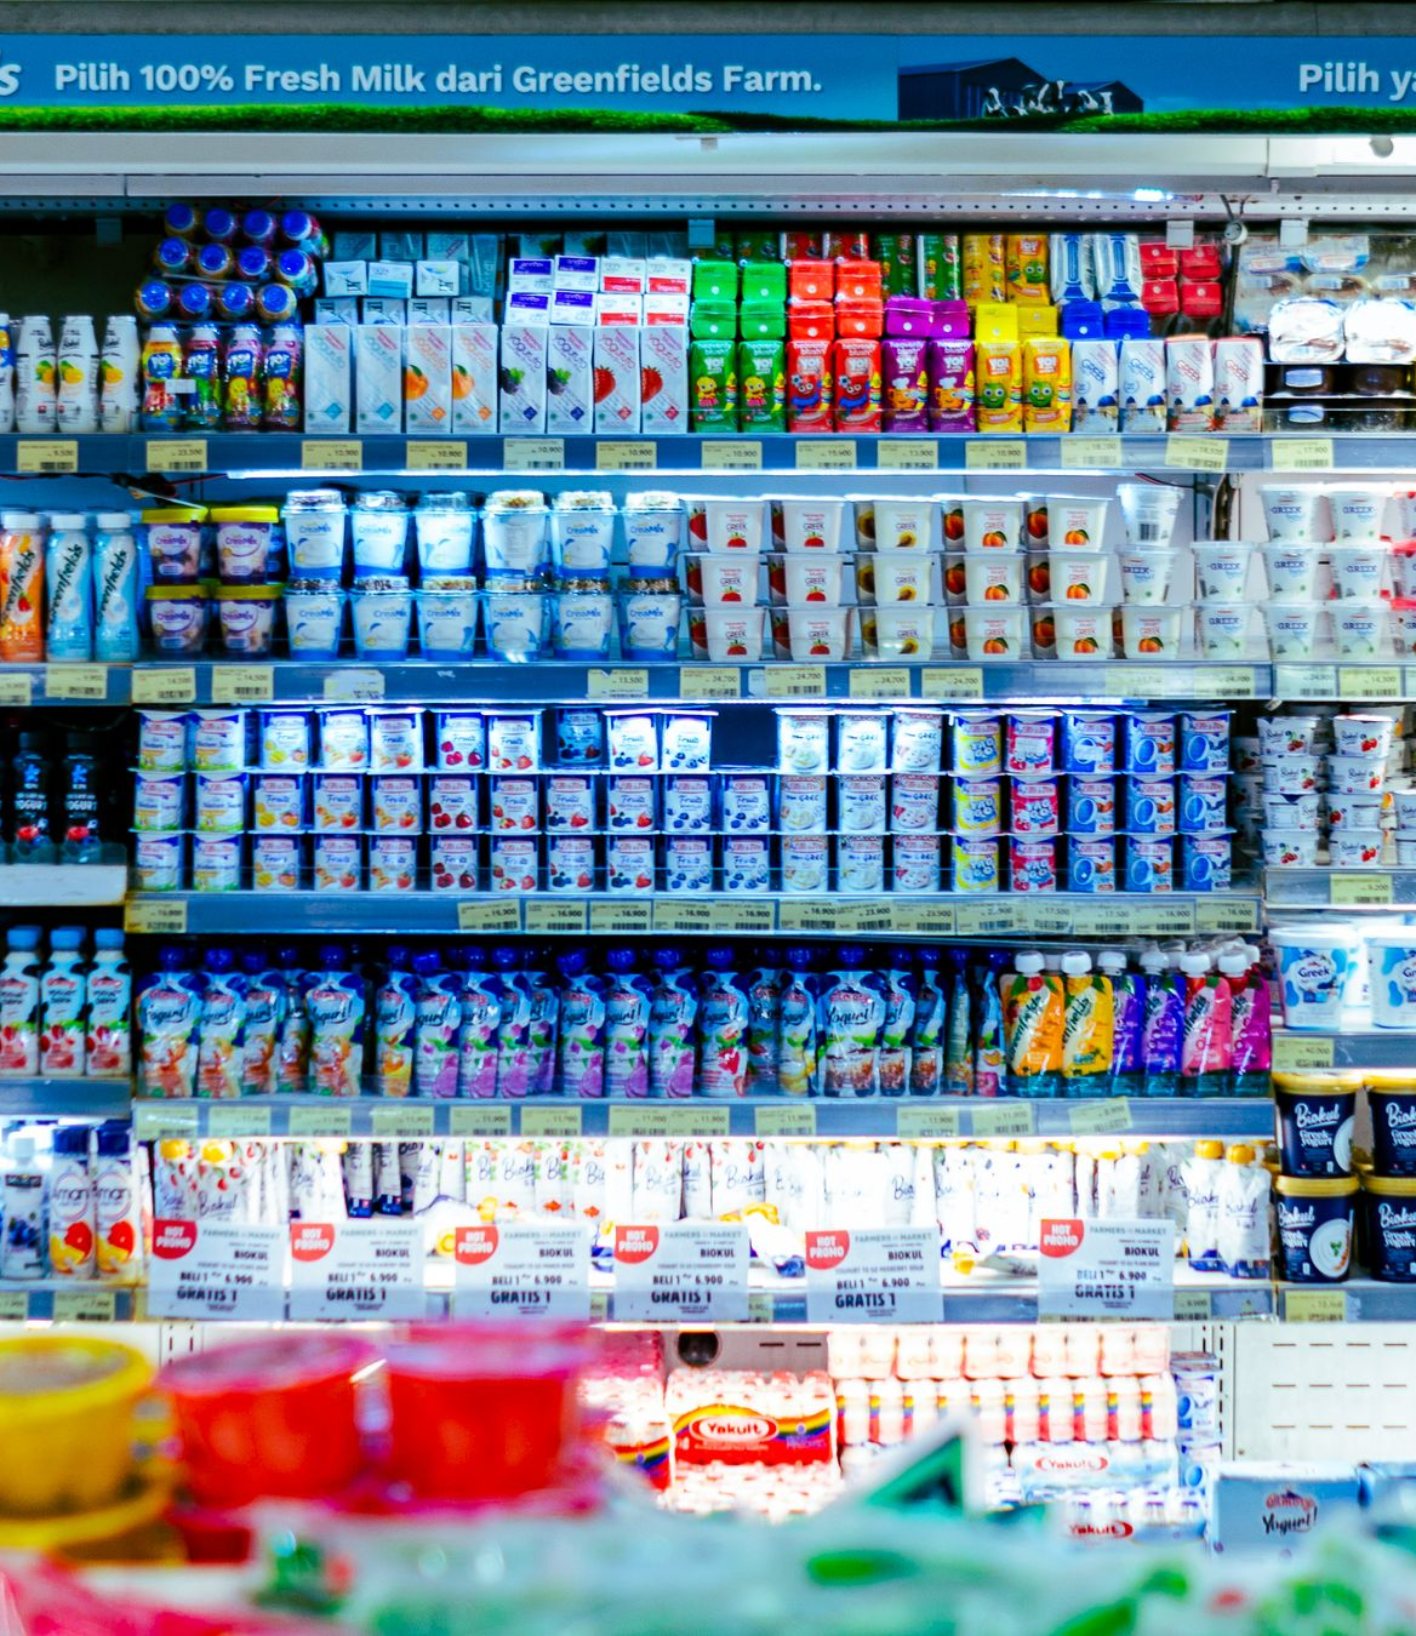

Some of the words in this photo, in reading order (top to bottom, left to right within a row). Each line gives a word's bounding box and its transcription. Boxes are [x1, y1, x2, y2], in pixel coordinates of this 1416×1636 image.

[56, 63, 129, 91] Pilih
[140, 65, 234, 91] 100%
[245, 64, 340, 91] Fresh
[352, 64, 425, 91] Milk
[436, 64, 502, 92] dari
[513, 64, 713, 92] Greenfields
[725, 66, 821, 92] Farm.
[1300, 62, 1379, 92] Pilih
[1051, 1224, 1072, 1235] HOT
[1135, 1227, 1167, 1235] MARKET
[816, 1236, 836, 1247] HOT
[1044, 1234, 1079, 1246] PROMO
[234, 1250, 268, 1260] BIOKUL
[375, 1248, 410, 1258] BIOKUL
[539, 1248, 573, 1257] BIOKUL
[700, 1248, 735, 1258] BIOKUL
[810, 1246, 844, 1258] PROMO
[888, 1250, 923, 1261] BIOKUL
[1124, 1247, 1159, 1257] BIOKUL
[328, 1273, 348, 1282] BELI
[492, 1275, 512, 1285] BELI
[653, 1275, 673, 1285] BELI
[695, 1275, 723, 1285] 6.900
[1119, 1270, 1146, 1280] 6.900
[837, 1280, 857, 1290] BELI
[882, 1278, 910, 1287] 6.900
[177, 1286, 227, 1301] GRATIS
[232, 1290, 237, 1302] 1
[326, 1287, 375, 1301] GRATIS
[381, 1287, 386, 1301] 1
[490, 1290, 540, 1304] GRATIS
[545, 1291, 550, 1303] 1
[651, 1290, 701, 1303] GRATIS
[706, 1291, 711, 1303] 1
[1075, 1284, 1124, 1299] GRATIS
[1129, 1284, 1135, 1299] 1
[835, 1292, 885, 1308] GRATIS
[889, 1292, 896, 1306] 1
[707, 1422, 762, 1435] Yakult
